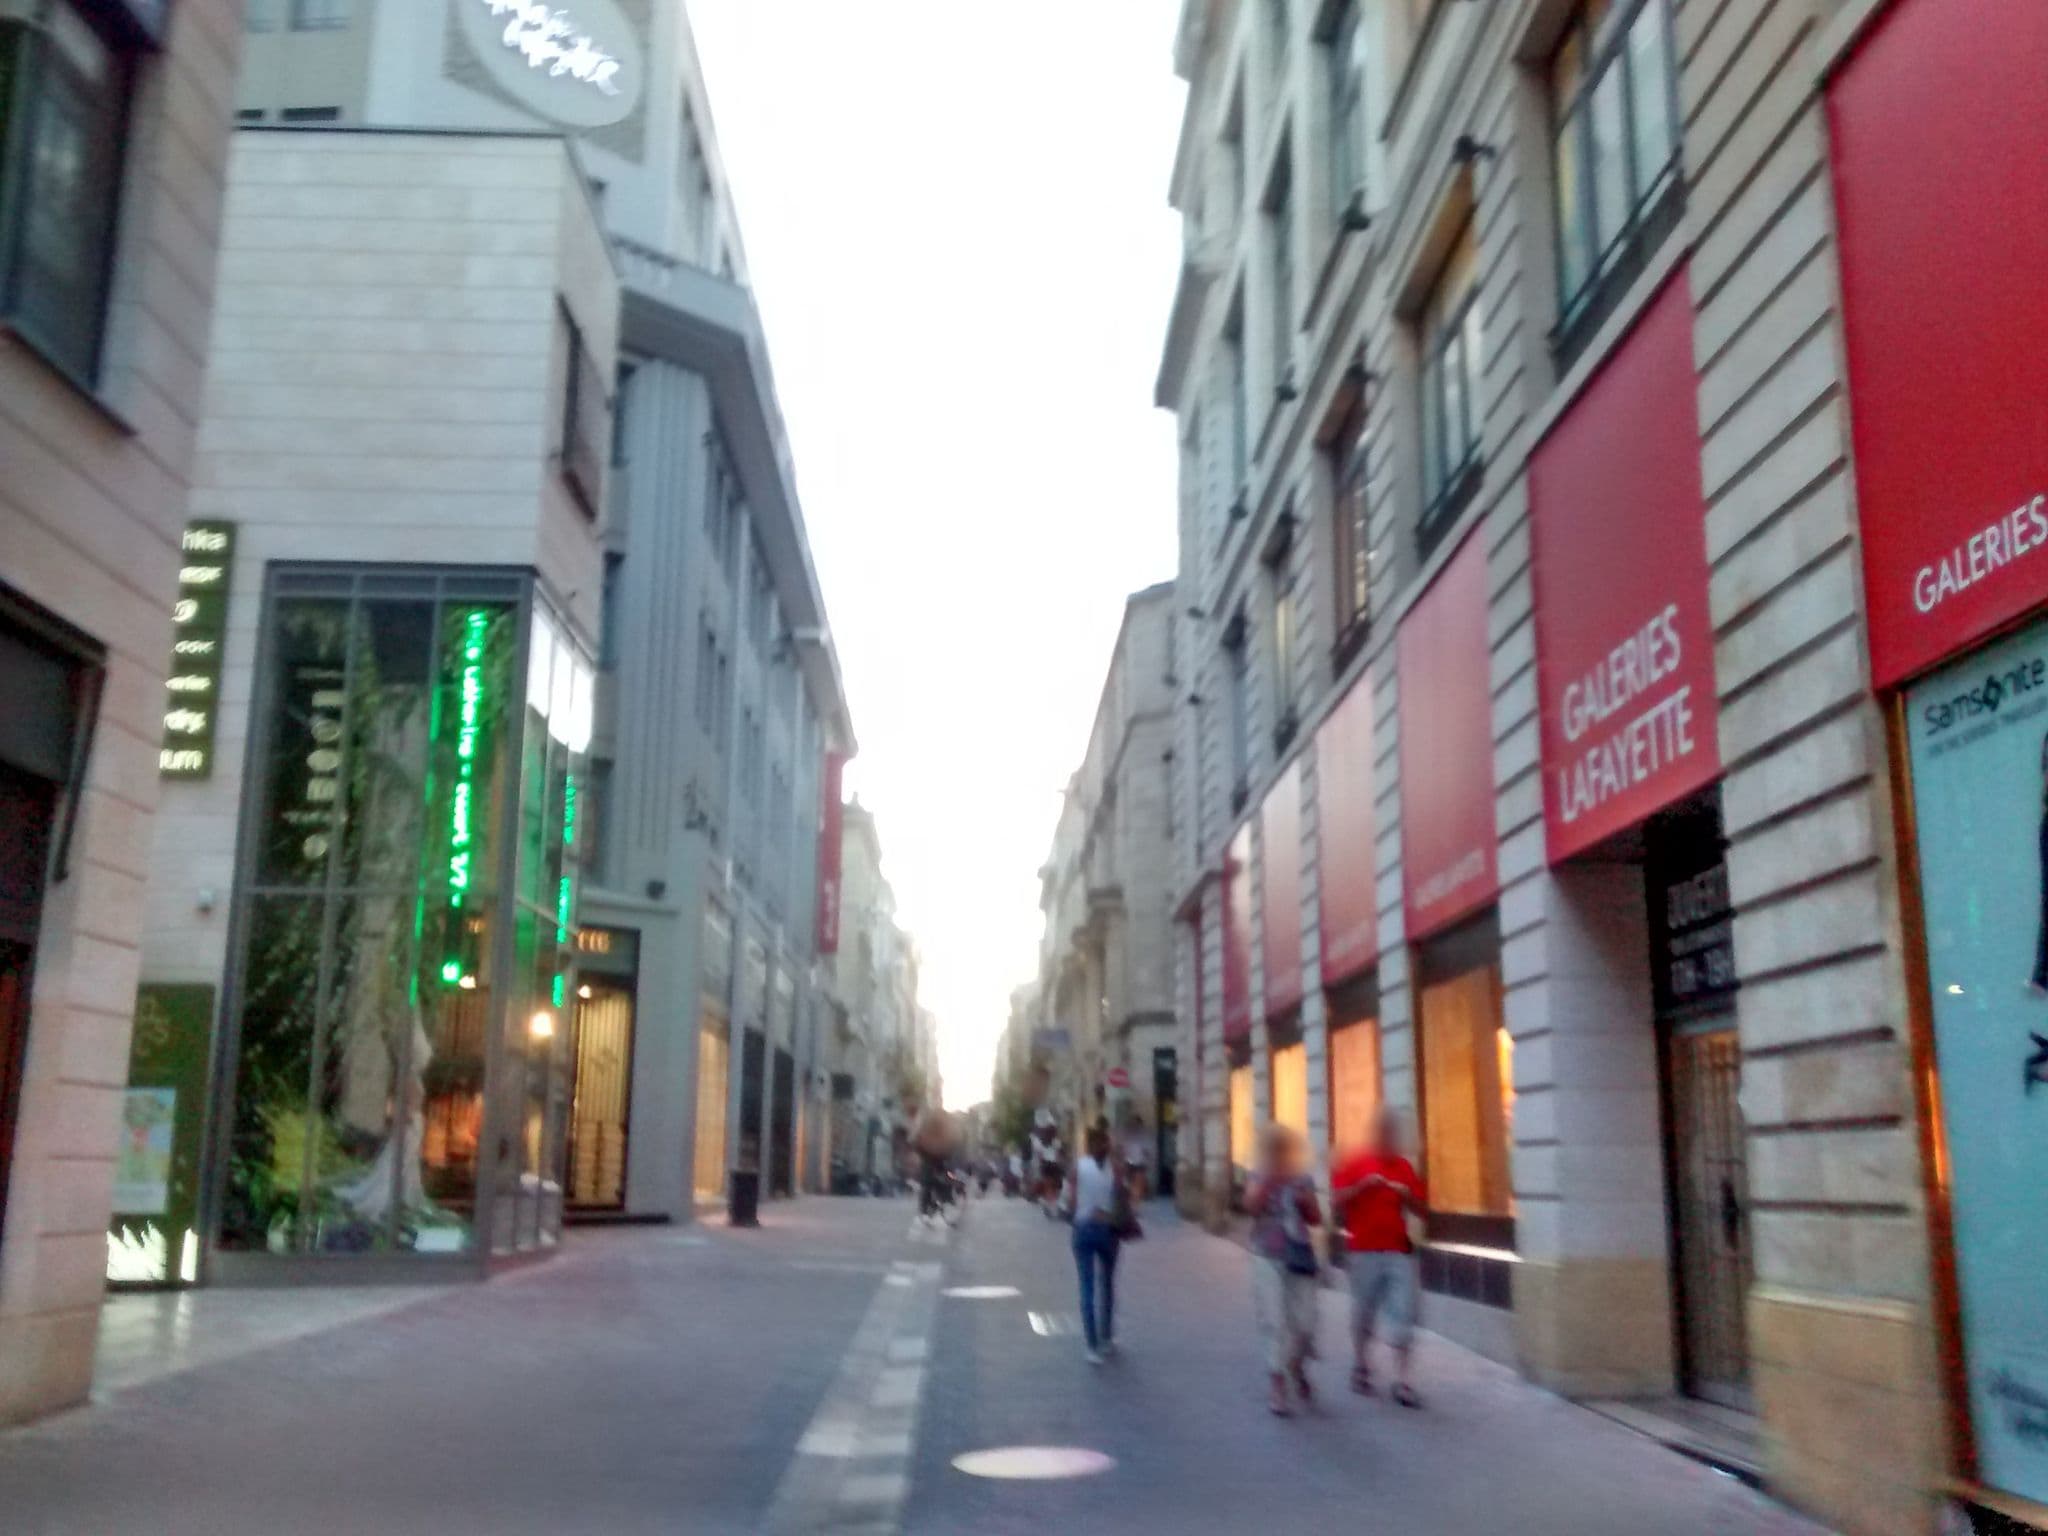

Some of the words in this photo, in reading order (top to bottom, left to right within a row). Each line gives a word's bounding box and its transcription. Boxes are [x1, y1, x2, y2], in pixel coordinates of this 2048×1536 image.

[1913, 494, 2048, 613] GALERIES
[1561, 602, 1681, 742] GALERIES
[1924, 656, 2046, 737] Samsonite
[1559, 684, 1695, 823] LAFAYETTE
